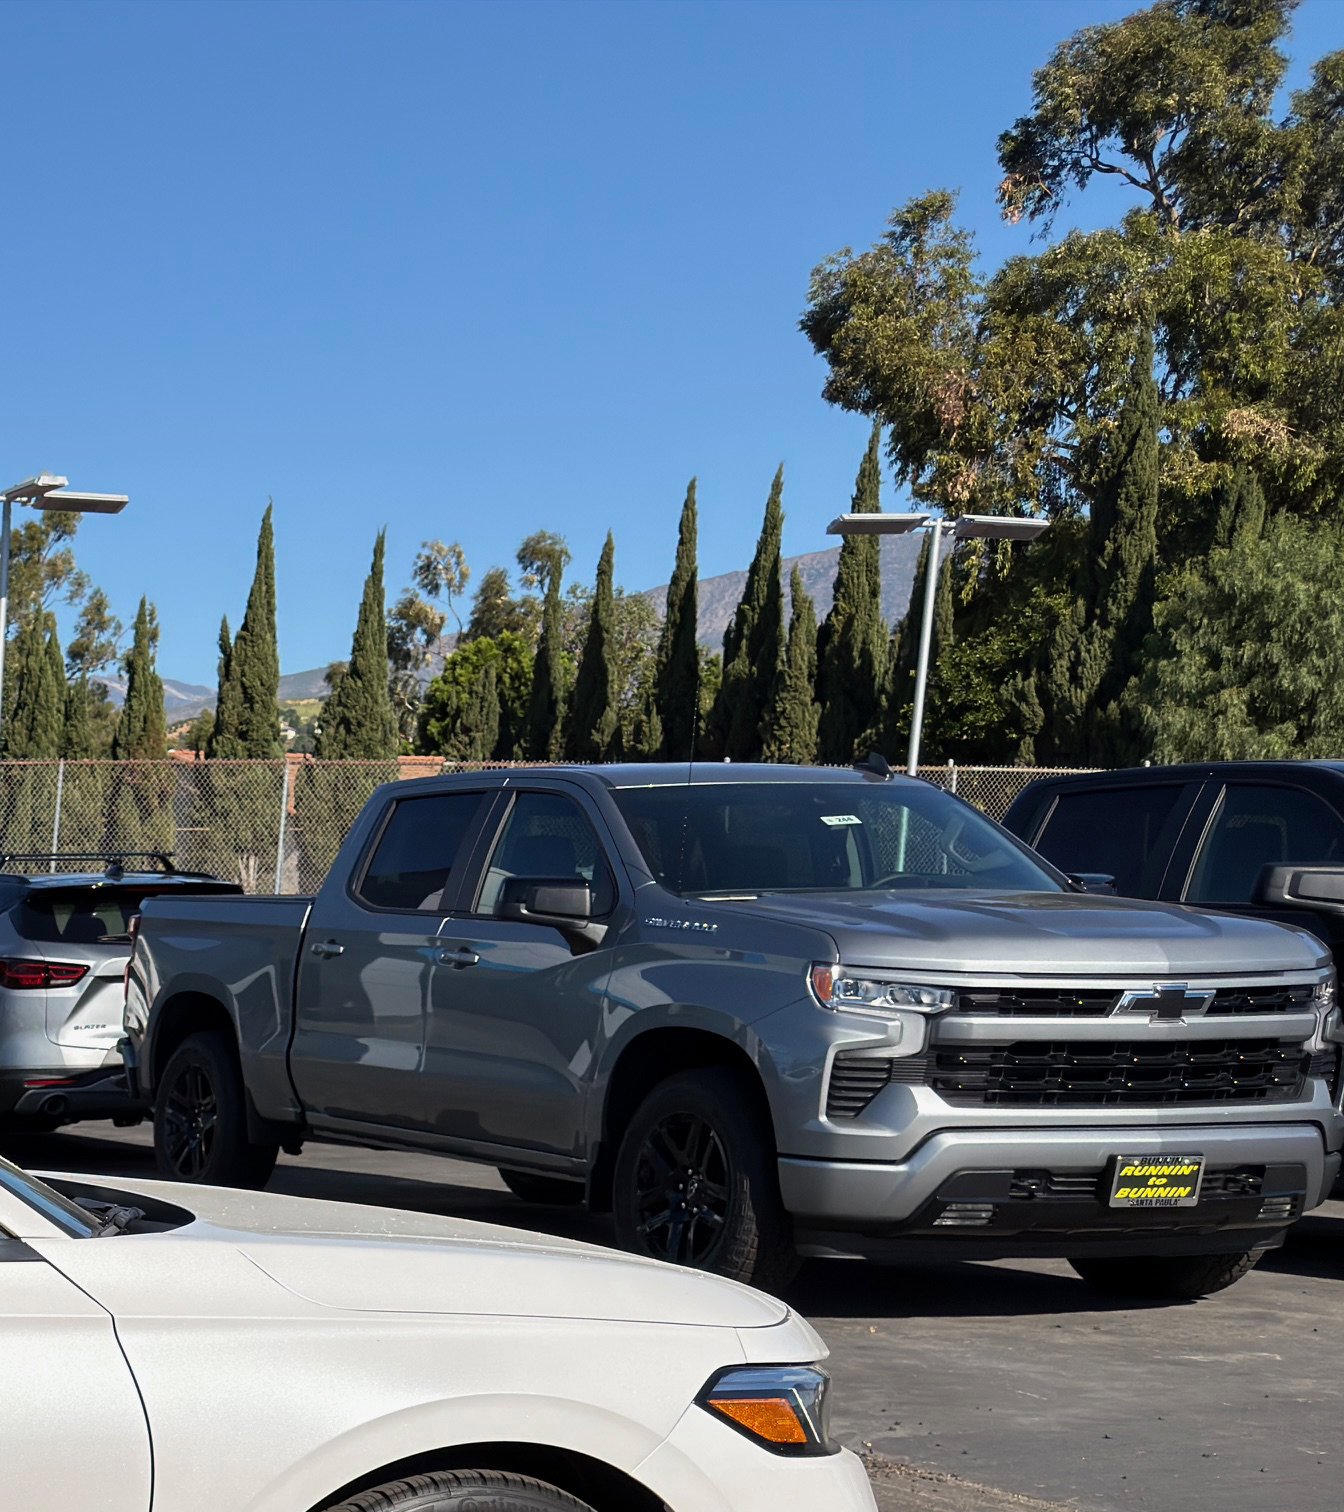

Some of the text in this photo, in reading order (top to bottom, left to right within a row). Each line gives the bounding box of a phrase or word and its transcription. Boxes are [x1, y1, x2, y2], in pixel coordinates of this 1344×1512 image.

[1119, 1165, 1199, 1176] RUNNIN'
[1147, 1176, 1168, 1185] to
[1114, 1186, 1192, 1199] BUNNIN
